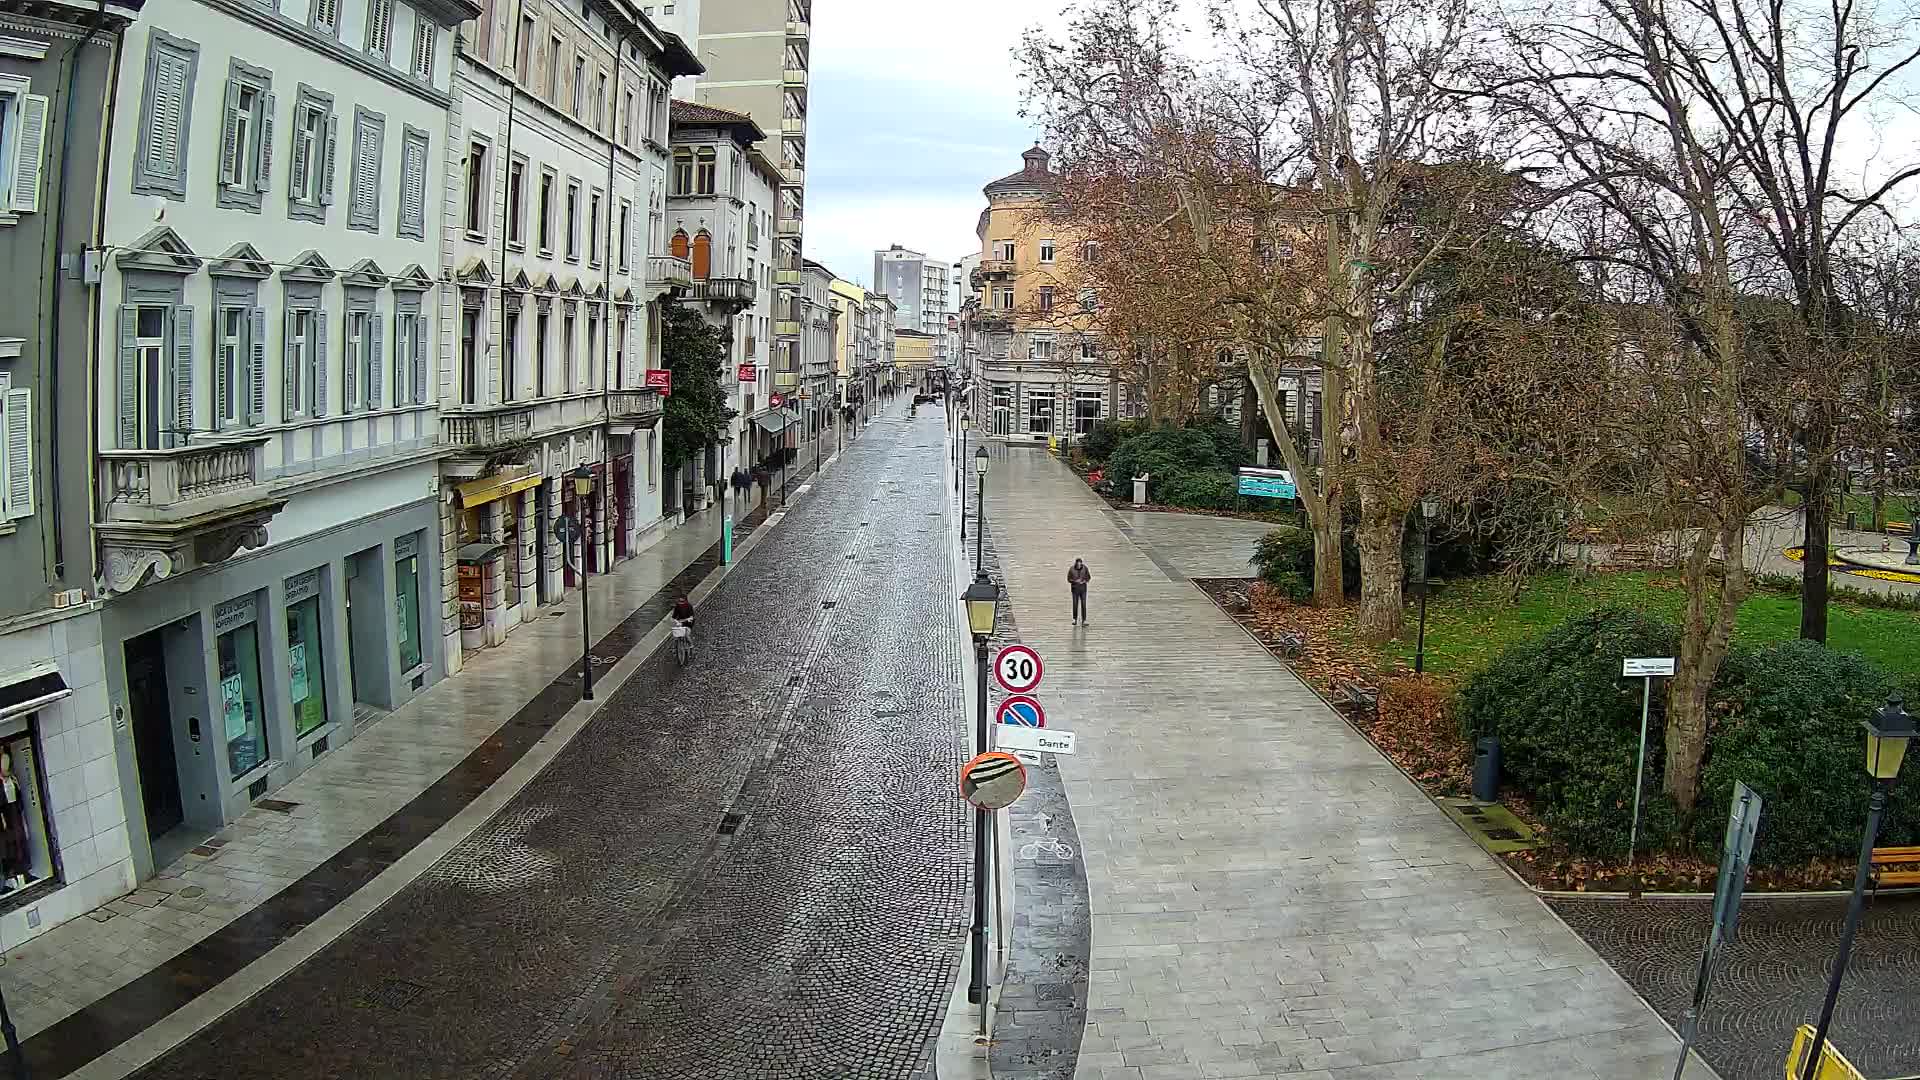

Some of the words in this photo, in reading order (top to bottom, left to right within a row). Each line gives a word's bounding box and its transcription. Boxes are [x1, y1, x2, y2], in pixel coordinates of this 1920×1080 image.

[1006, 658, 1033, 680] 30
[222, 677, 241, 700] 130
[1039, 738, 1070, 749] Dante
